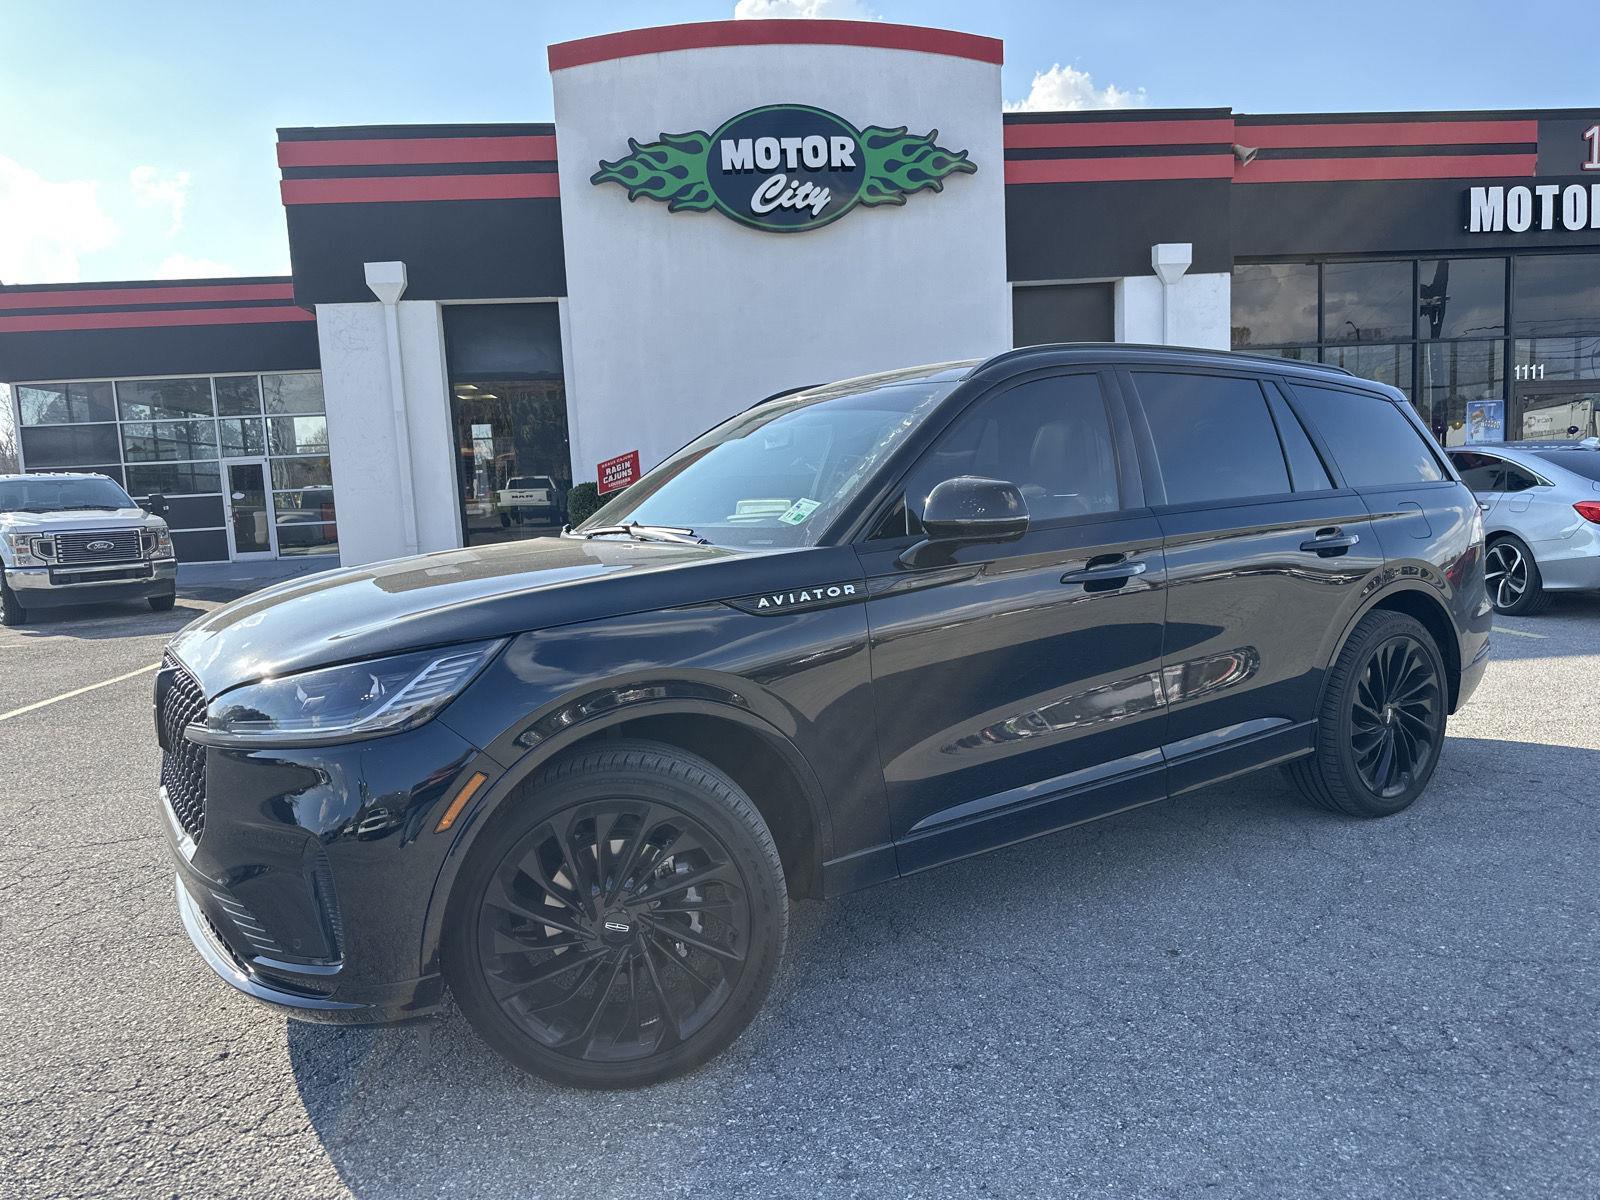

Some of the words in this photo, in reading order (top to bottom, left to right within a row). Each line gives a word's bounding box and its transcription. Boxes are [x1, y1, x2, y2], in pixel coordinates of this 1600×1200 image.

[720, 135, 856, 171] MOTOR
[750, 173, 832, 216] City
[1514, 364, 1545, 380] 1111
[603, 468, 632, 484] CAJUNS
[757, 584, 856, 608] AVIATOR
